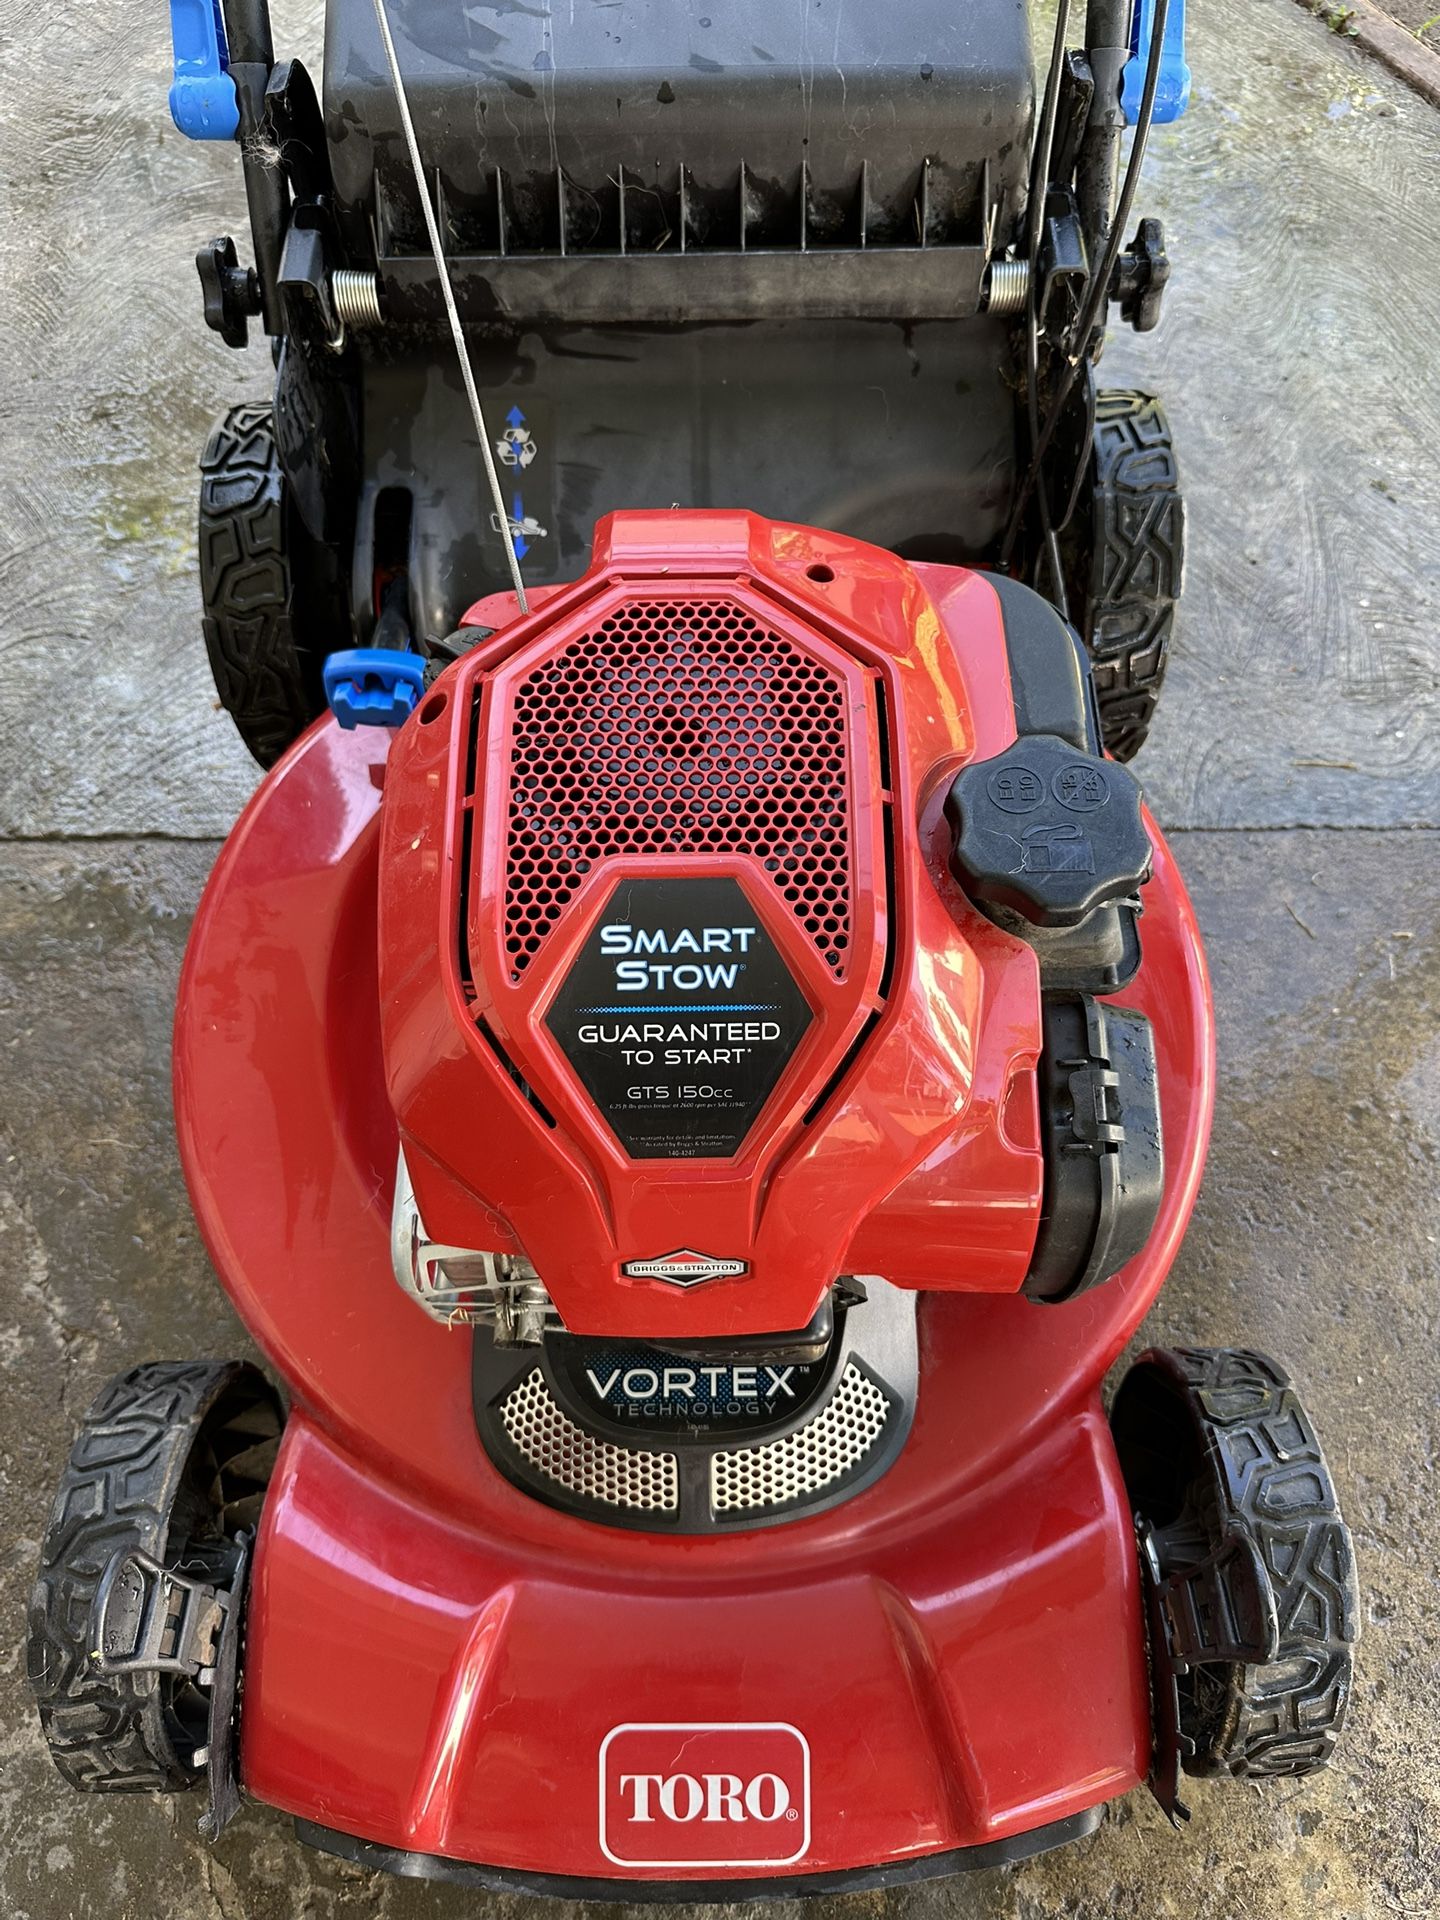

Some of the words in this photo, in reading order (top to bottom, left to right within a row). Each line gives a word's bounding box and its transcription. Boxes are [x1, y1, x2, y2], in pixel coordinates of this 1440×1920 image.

[1018, 776, 1037, 801] E10
[600, 924, 756, 955] SMART
[577, 1022, 781, 1043] GUARANTEED
[621, 1050, 654, 1066] TO
[626, 1086, 670, 1100] GTS
[677, 1085, 733, 1099] 150cc
[613, 1401, 777, 1417] TECHNOLOGY
